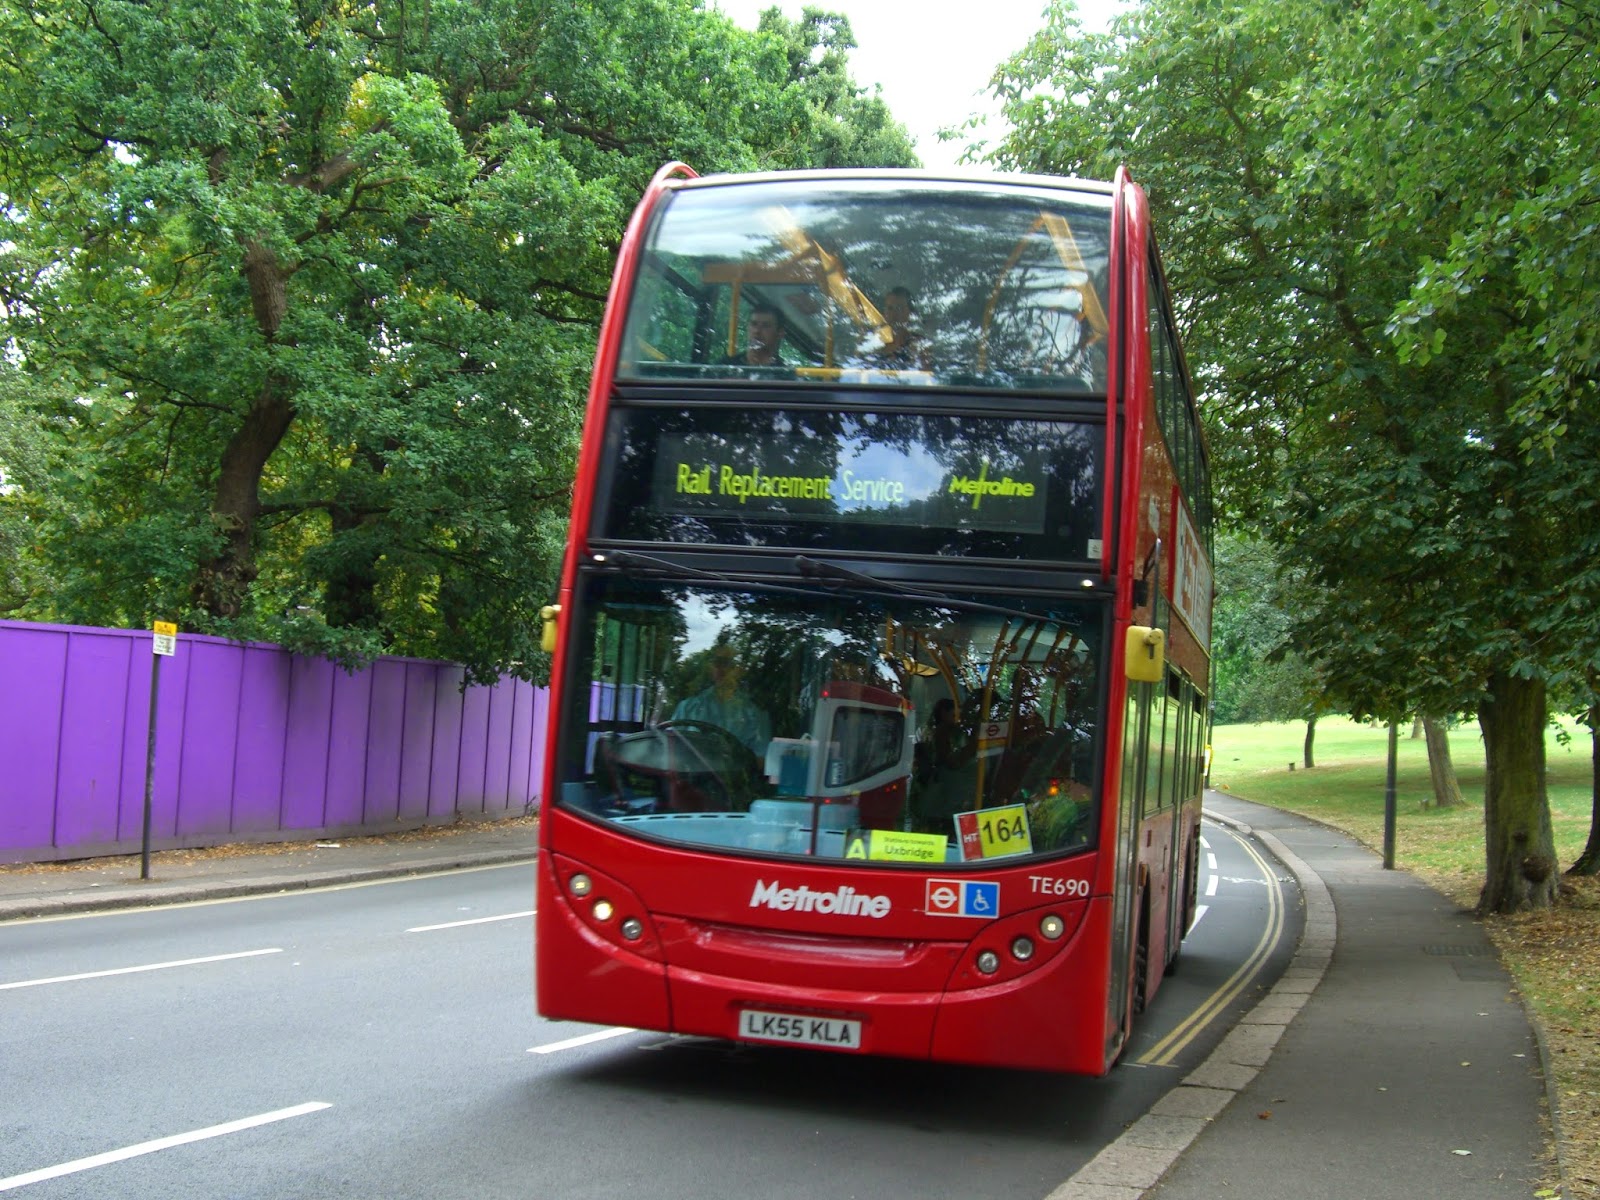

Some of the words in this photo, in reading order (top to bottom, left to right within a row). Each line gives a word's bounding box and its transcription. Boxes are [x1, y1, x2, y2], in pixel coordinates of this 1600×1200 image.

[676, 463, 711, 495] Rail
[719, 465, 832, 504] Replacement
[841, 469, 903, 502] Service
[949, 460, 1035, 510] Metroline
[963, 832, 979, 843] HT
[982, 815, 1025, 844] 164
[846, 838, 867, 860] A
[884, 845, 934, 859] Uxbridge
[749, 879, 892, 919] Metroline
[1028, 875, 1090, 897] TE690
[748, 1013, 805, 1039] LK55
[809, 1018, 851, 1044] KLA
